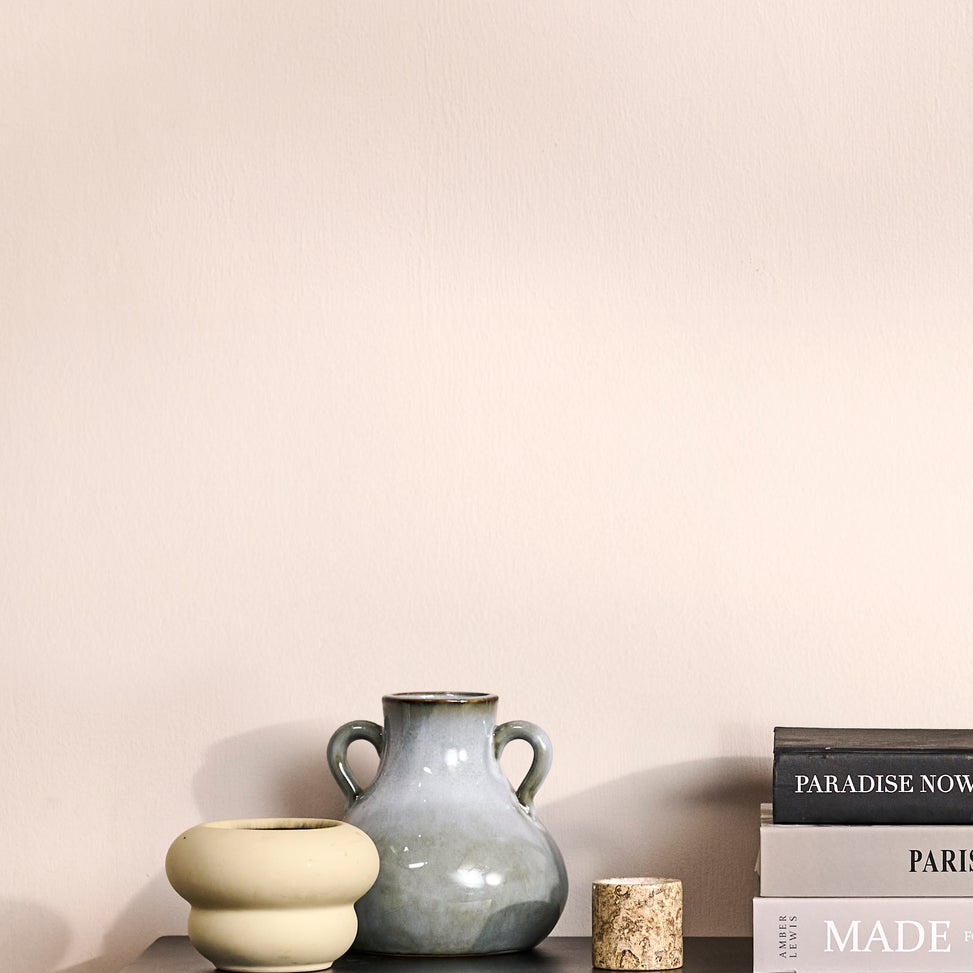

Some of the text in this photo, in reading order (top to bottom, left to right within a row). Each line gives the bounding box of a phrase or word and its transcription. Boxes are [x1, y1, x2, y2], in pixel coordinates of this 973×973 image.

[795, 774, 914, 794] PARADISE
[778, 915, 787, 959] AMBER
[789, 915, 798, 958] LEWIS
[823, 919, 952, 953] MADE
